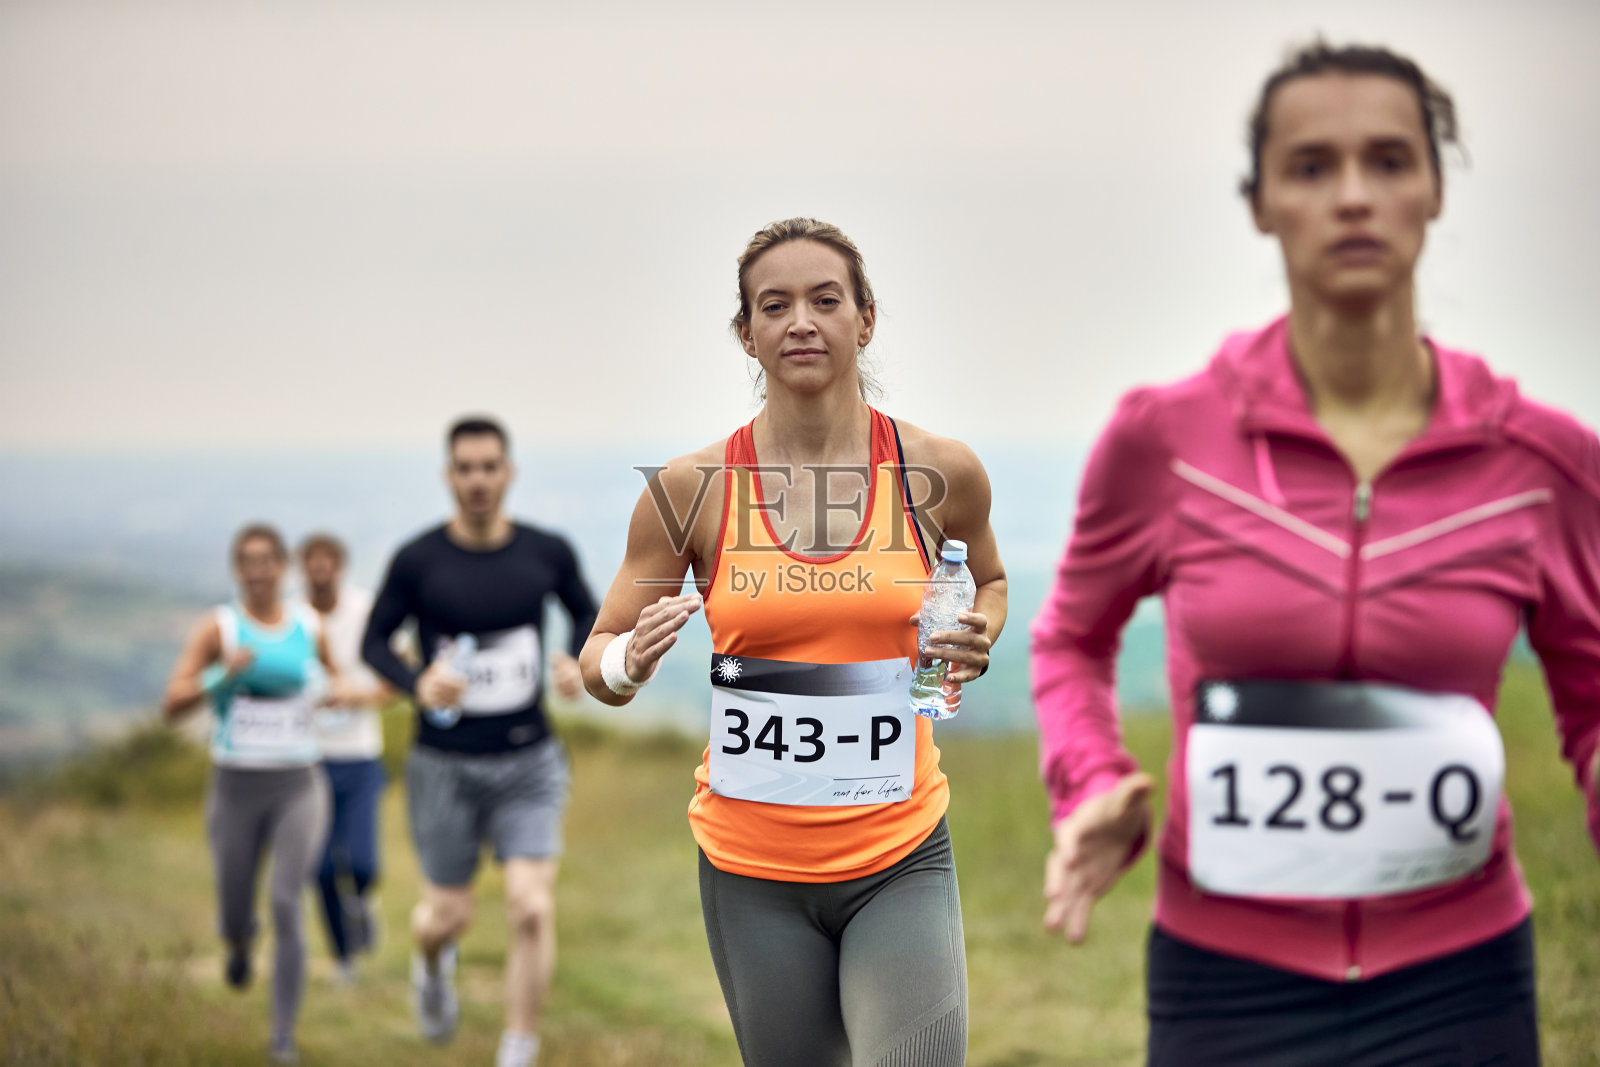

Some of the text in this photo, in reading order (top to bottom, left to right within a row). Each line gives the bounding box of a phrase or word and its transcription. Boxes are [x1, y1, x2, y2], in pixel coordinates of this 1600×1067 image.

[721, 708, 902, 763] 343-P
[853, 783, 873, 801] for
[1210, 763, 1483, 843] 128-Q
